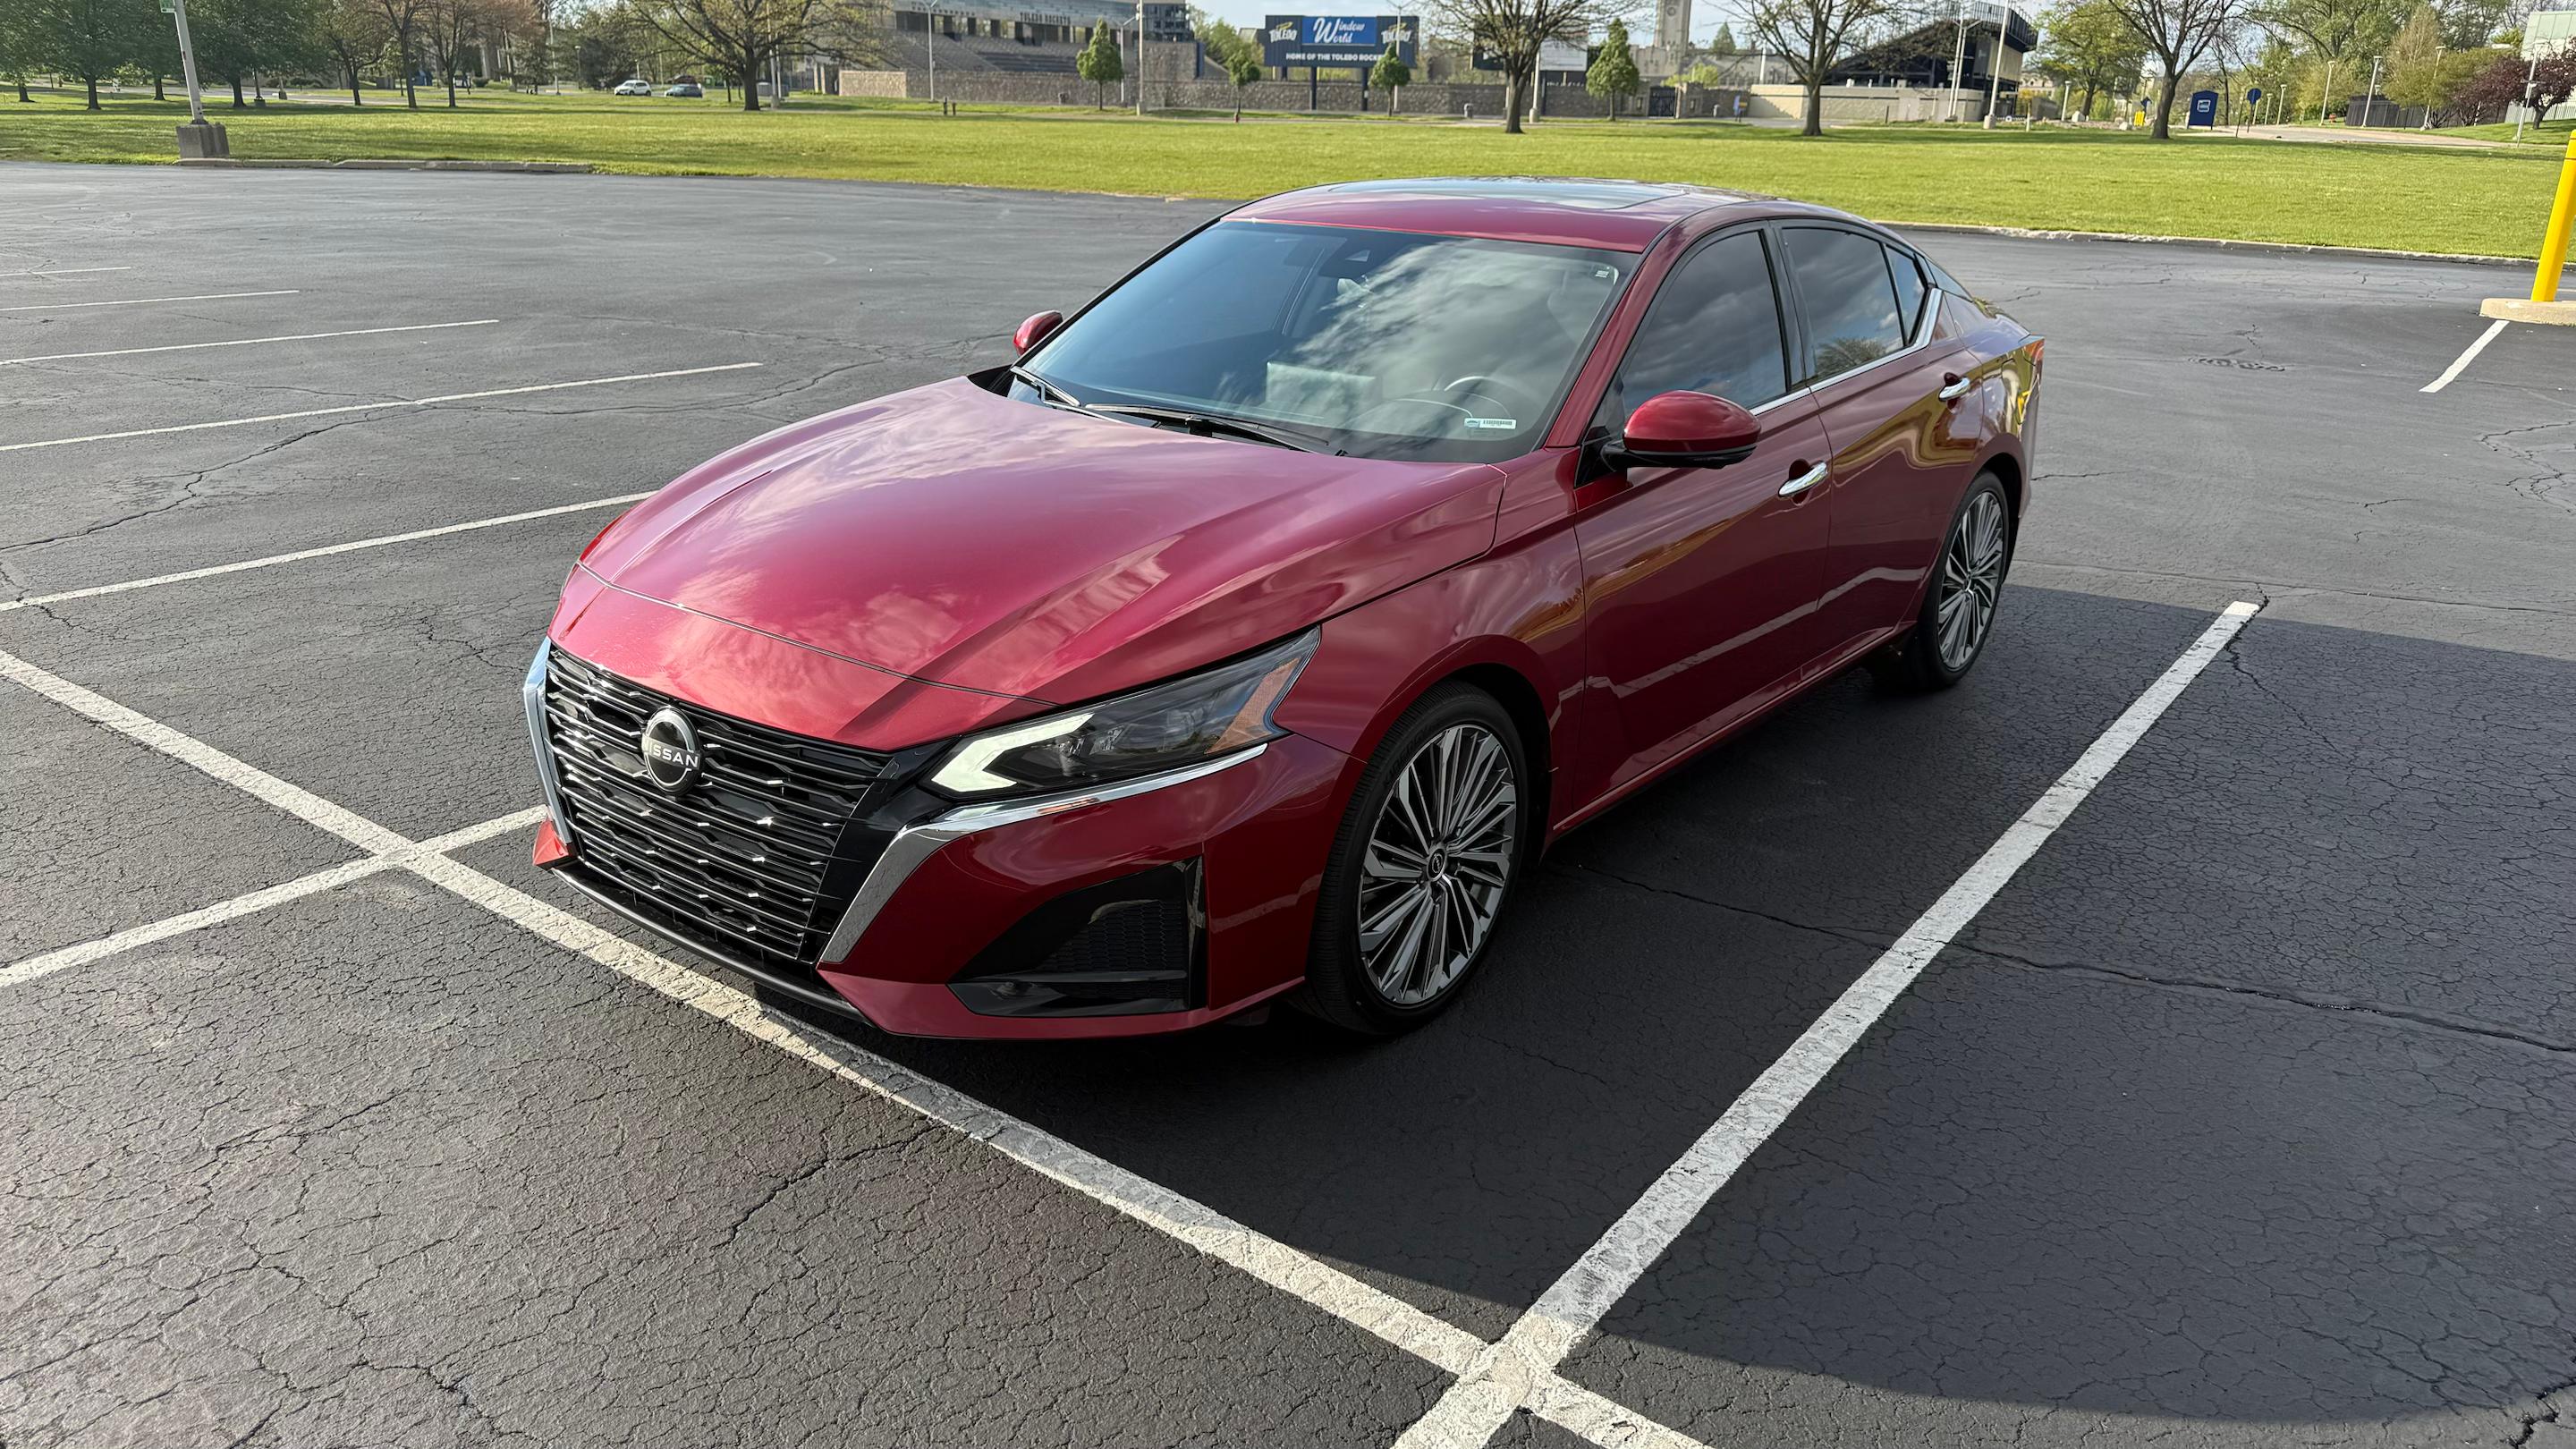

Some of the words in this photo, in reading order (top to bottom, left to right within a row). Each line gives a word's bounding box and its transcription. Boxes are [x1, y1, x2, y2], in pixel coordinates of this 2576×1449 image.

[1269, 29, 1298, 43] TOLEDO
[1313, 18, 1365, 43] Window
[1286, 53, 1306, 61] HOME
[1307, 53, 1317, 61] OF
[1317, 53, 1331, 61] THE
[644, 739, 699, 767] NISSAN
